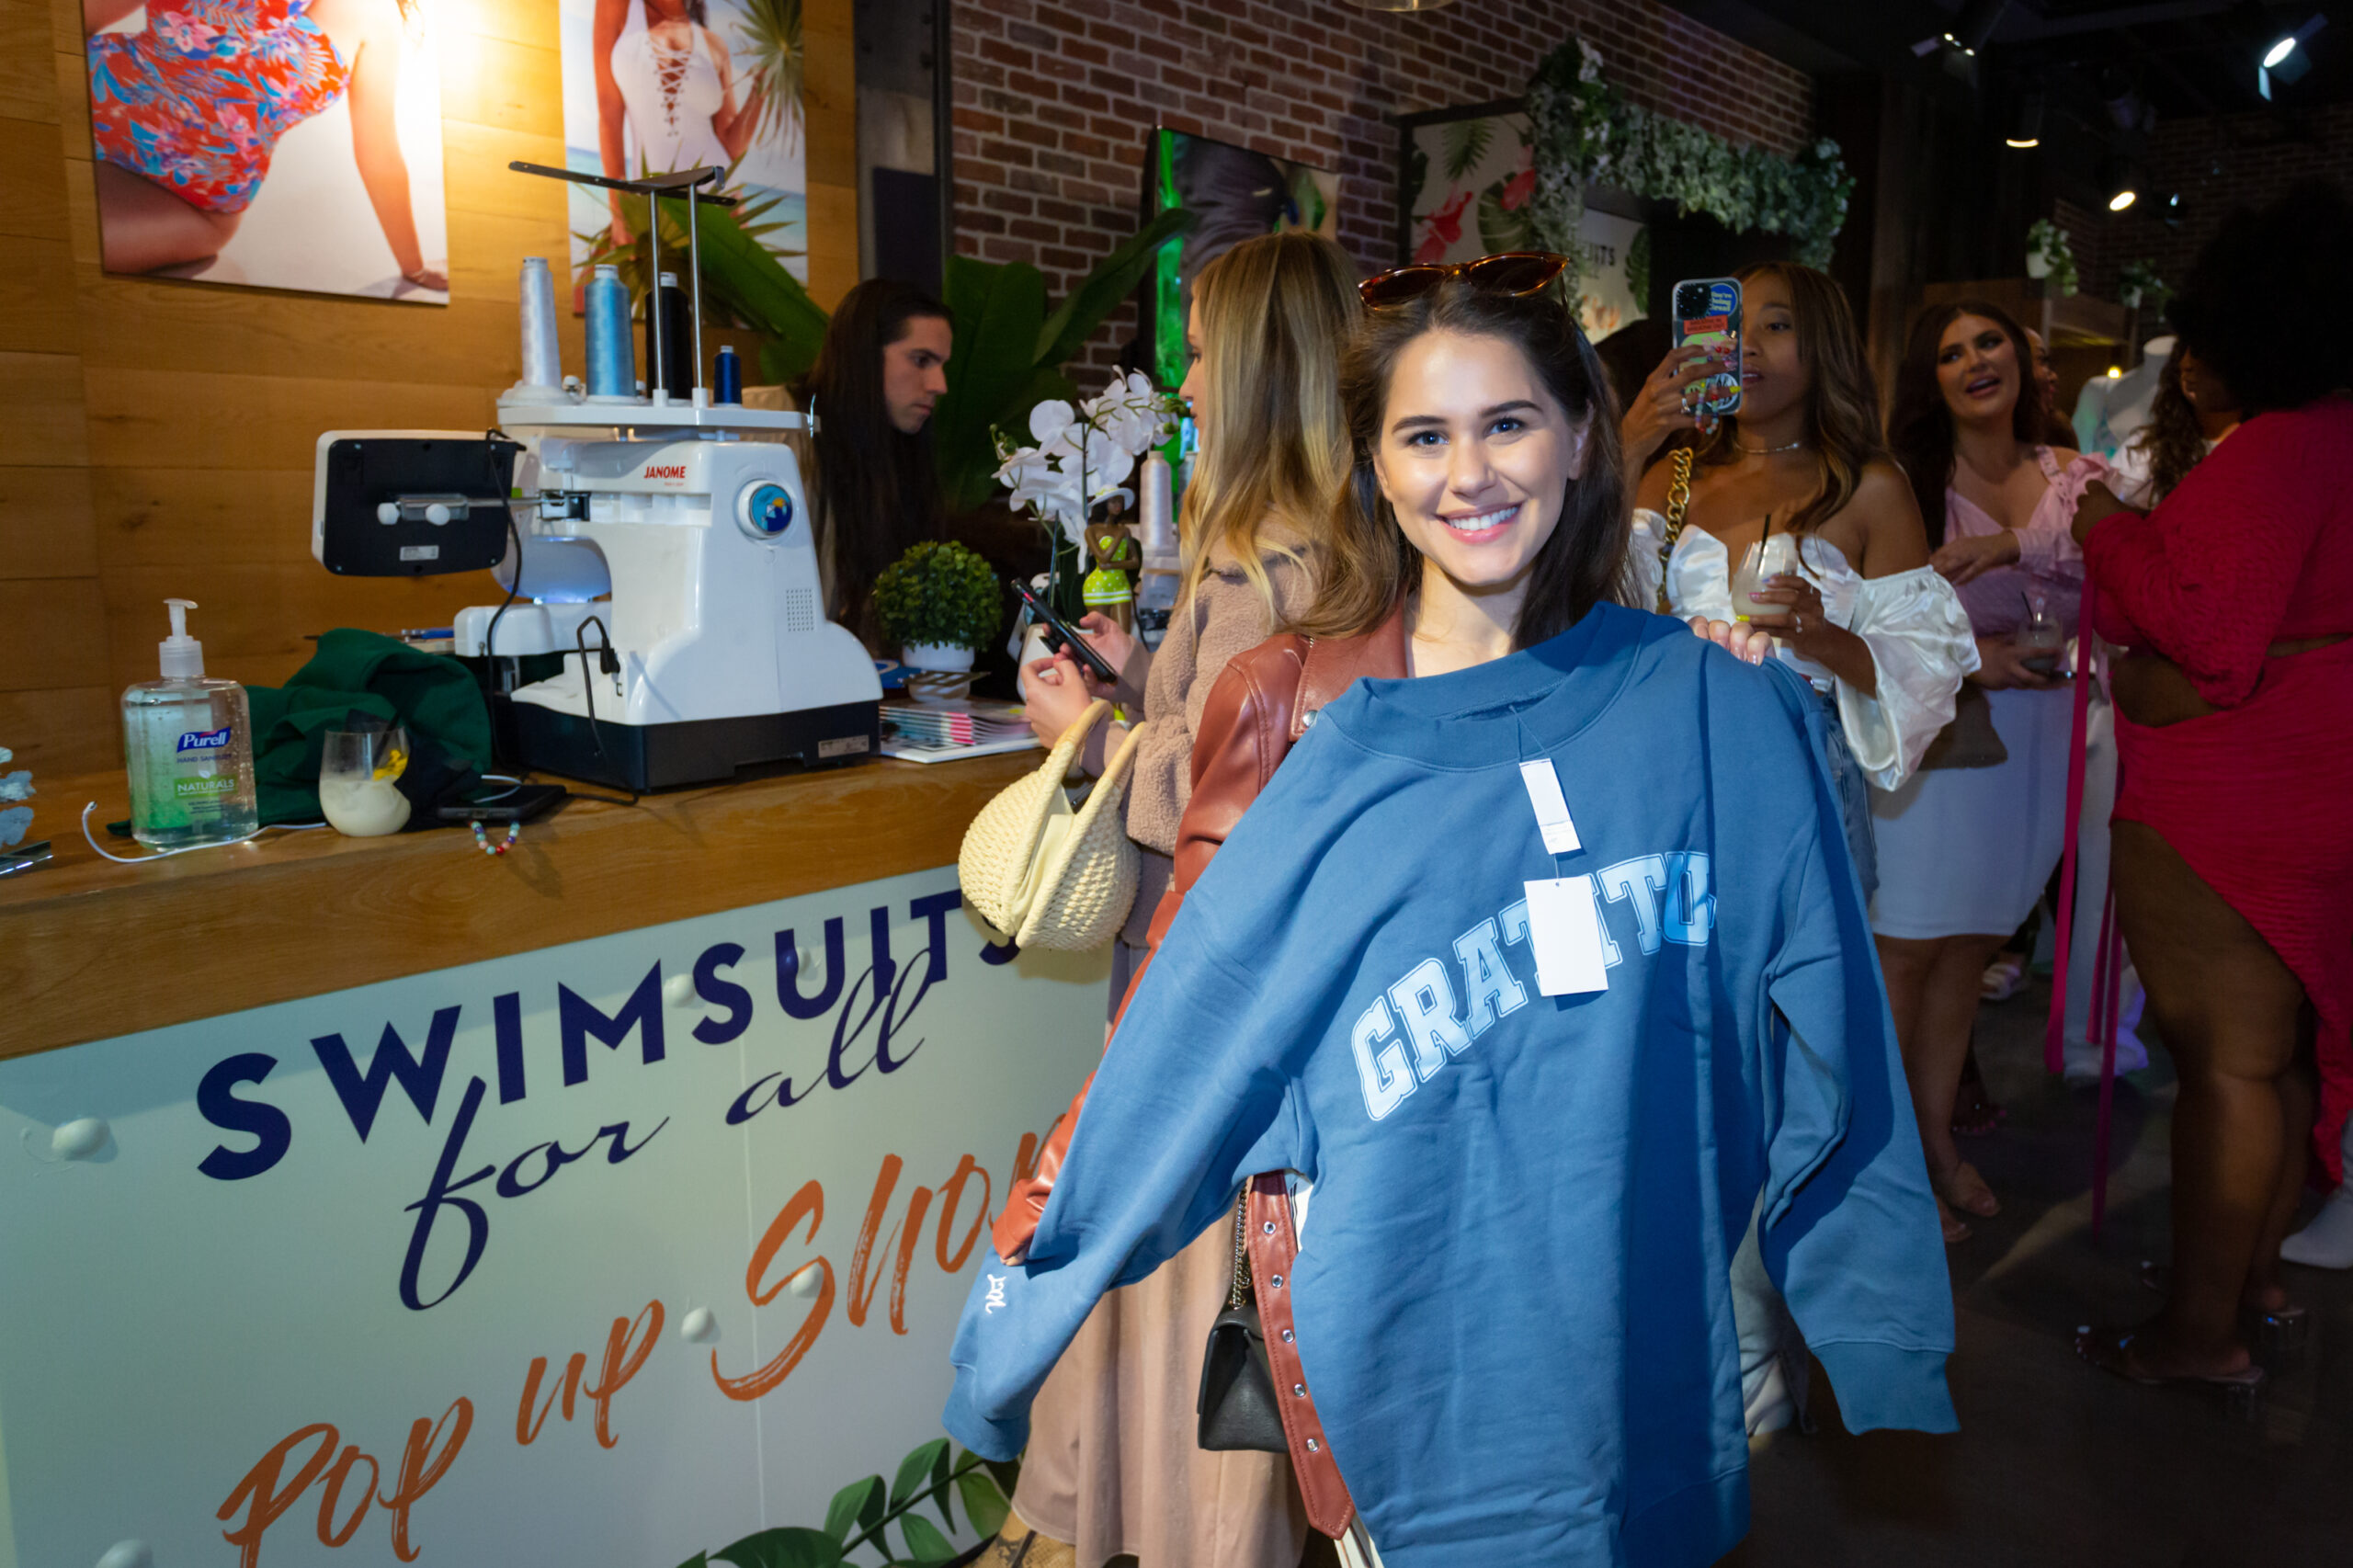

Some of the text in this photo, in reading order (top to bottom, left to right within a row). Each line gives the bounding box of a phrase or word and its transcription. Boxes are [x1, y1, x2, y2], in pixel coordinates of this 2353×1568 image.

[644, 466, 687, 479] JANOME
[183, 732, 227, 748] Purell
[177, 779, 234, 792] NATURALS
[399, 947, 926, 1311] for all
